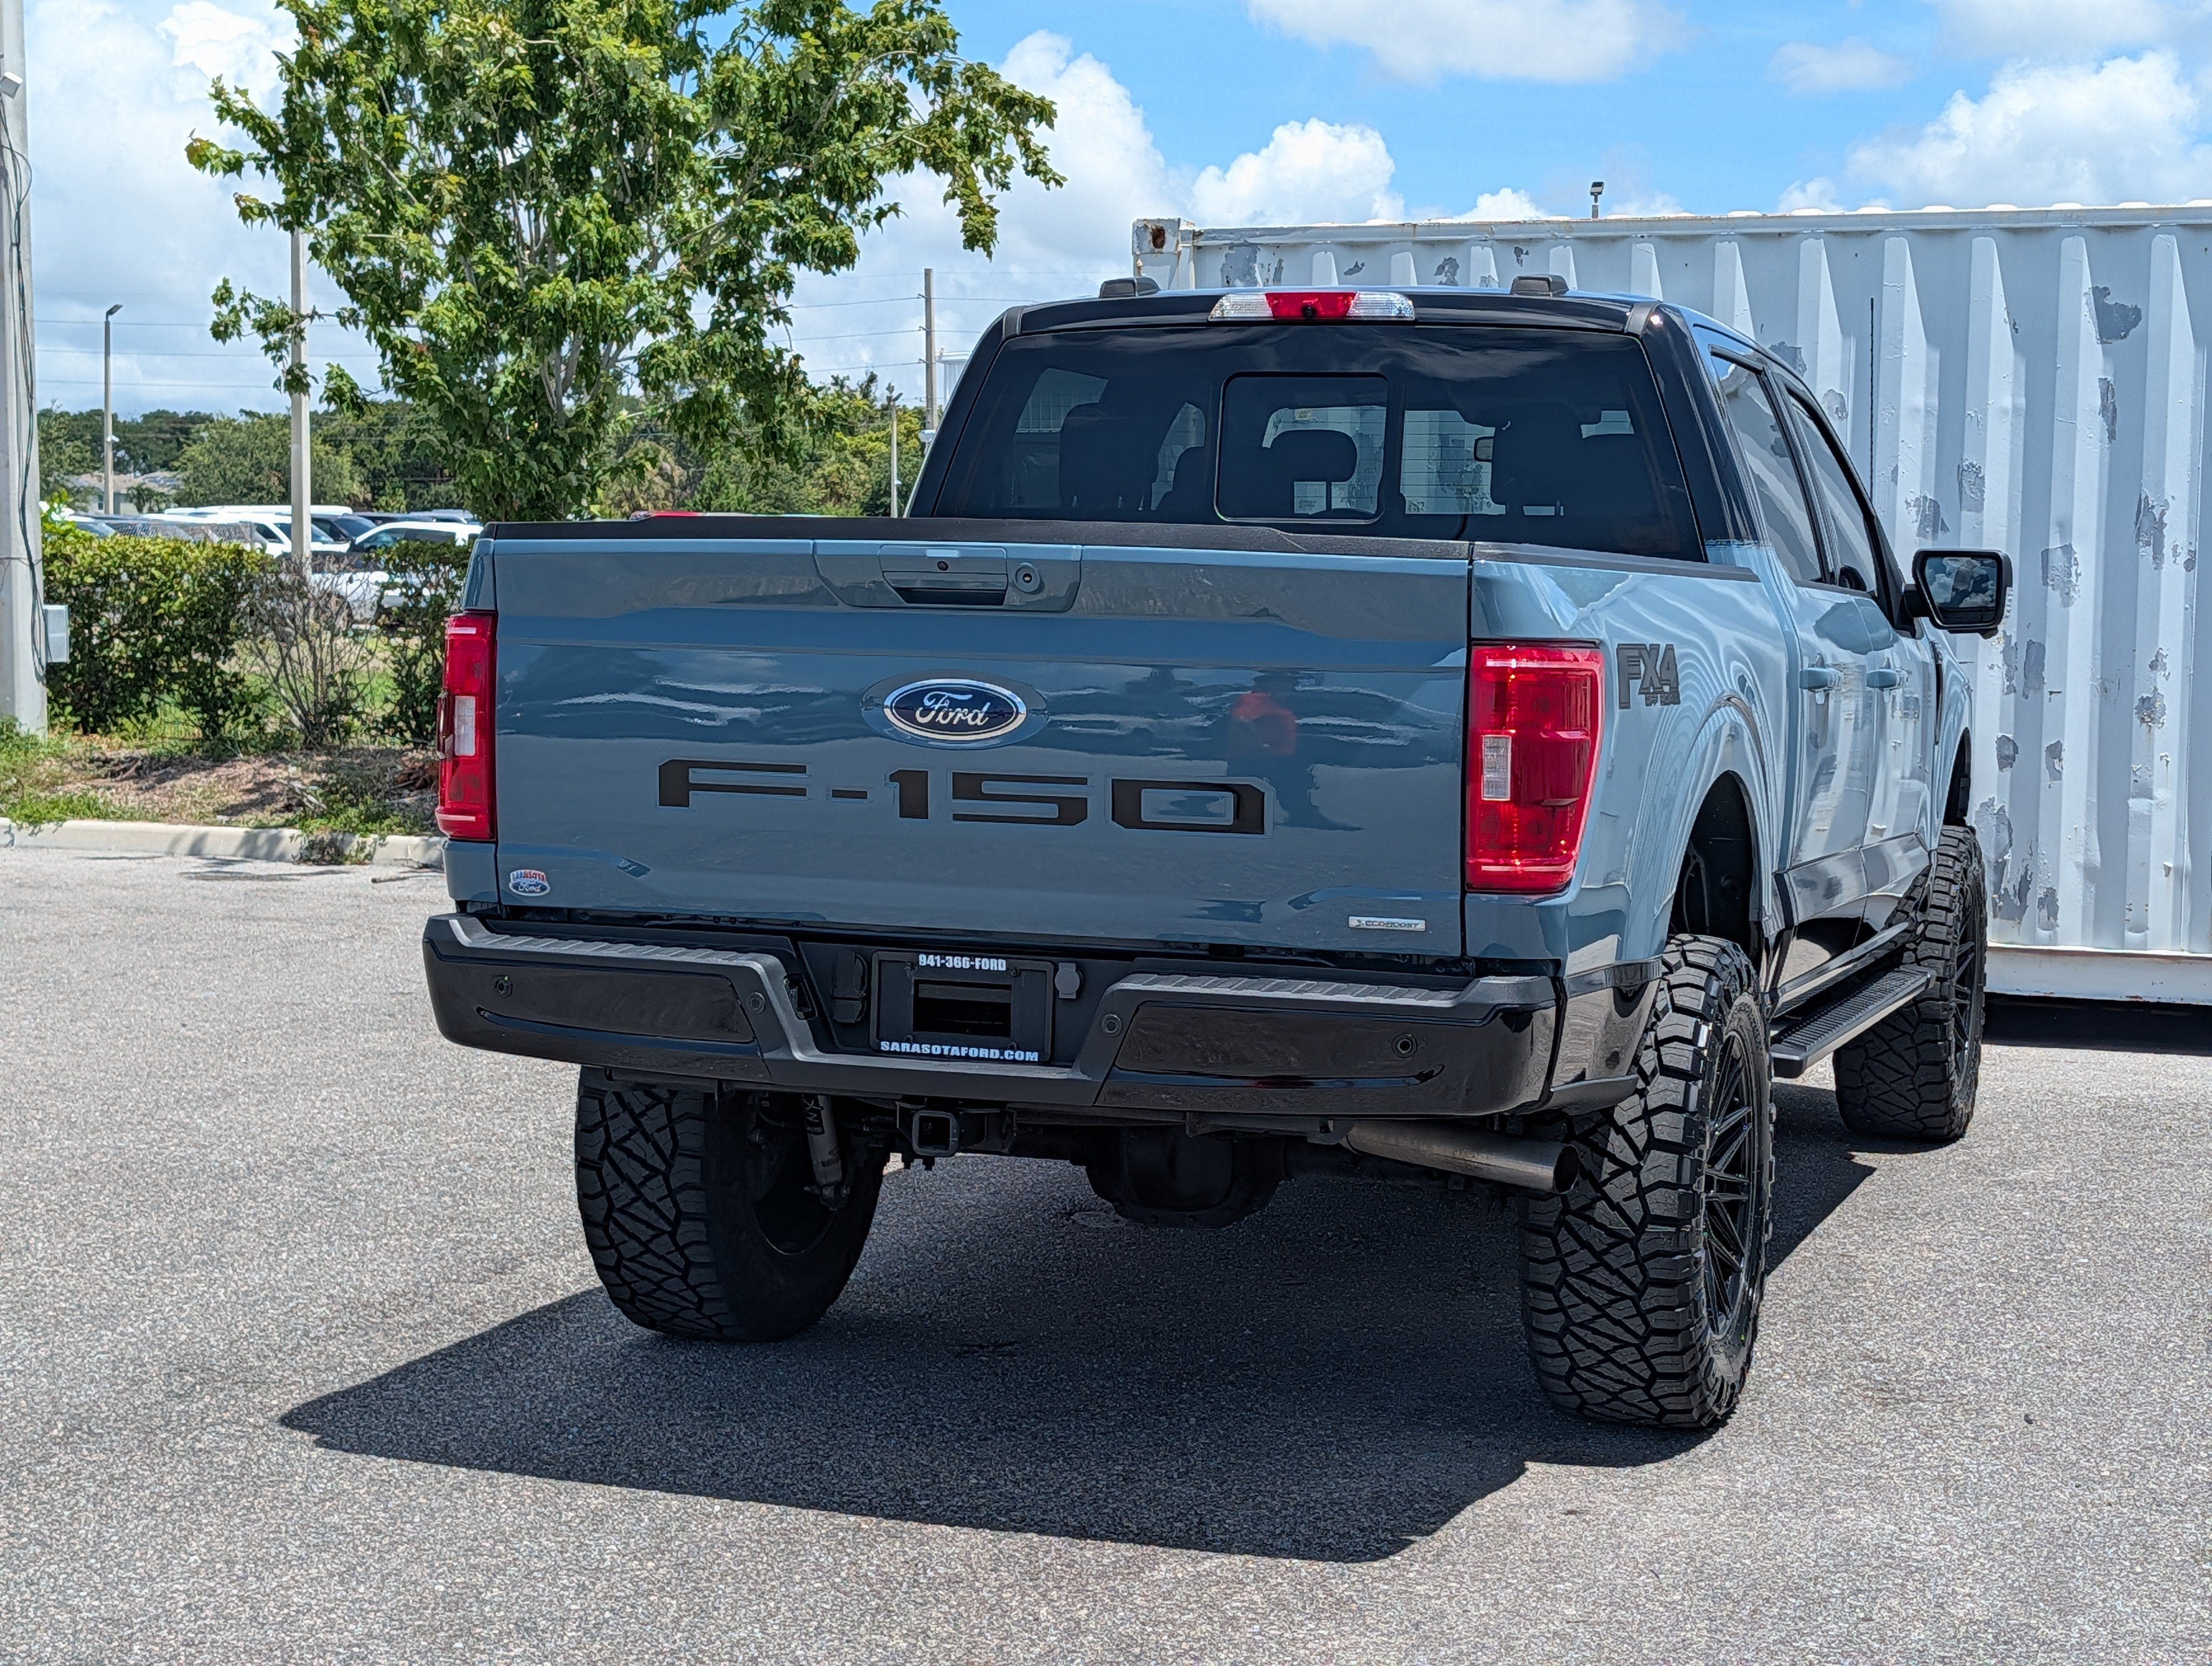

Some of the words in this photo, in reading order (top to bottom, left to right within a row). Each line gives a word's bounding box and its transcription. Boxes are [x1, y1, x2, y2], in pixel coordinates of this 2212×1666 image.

[1616, 644, 1680, 709] FX4
[915, 691, 991, 726] Ford
[658, 759, 1265, 835] F-150
[918, 953, 1007, 971] 941-366-FORD
[880, 1041, 1039, 1062] SARASOTAFORD.COM
